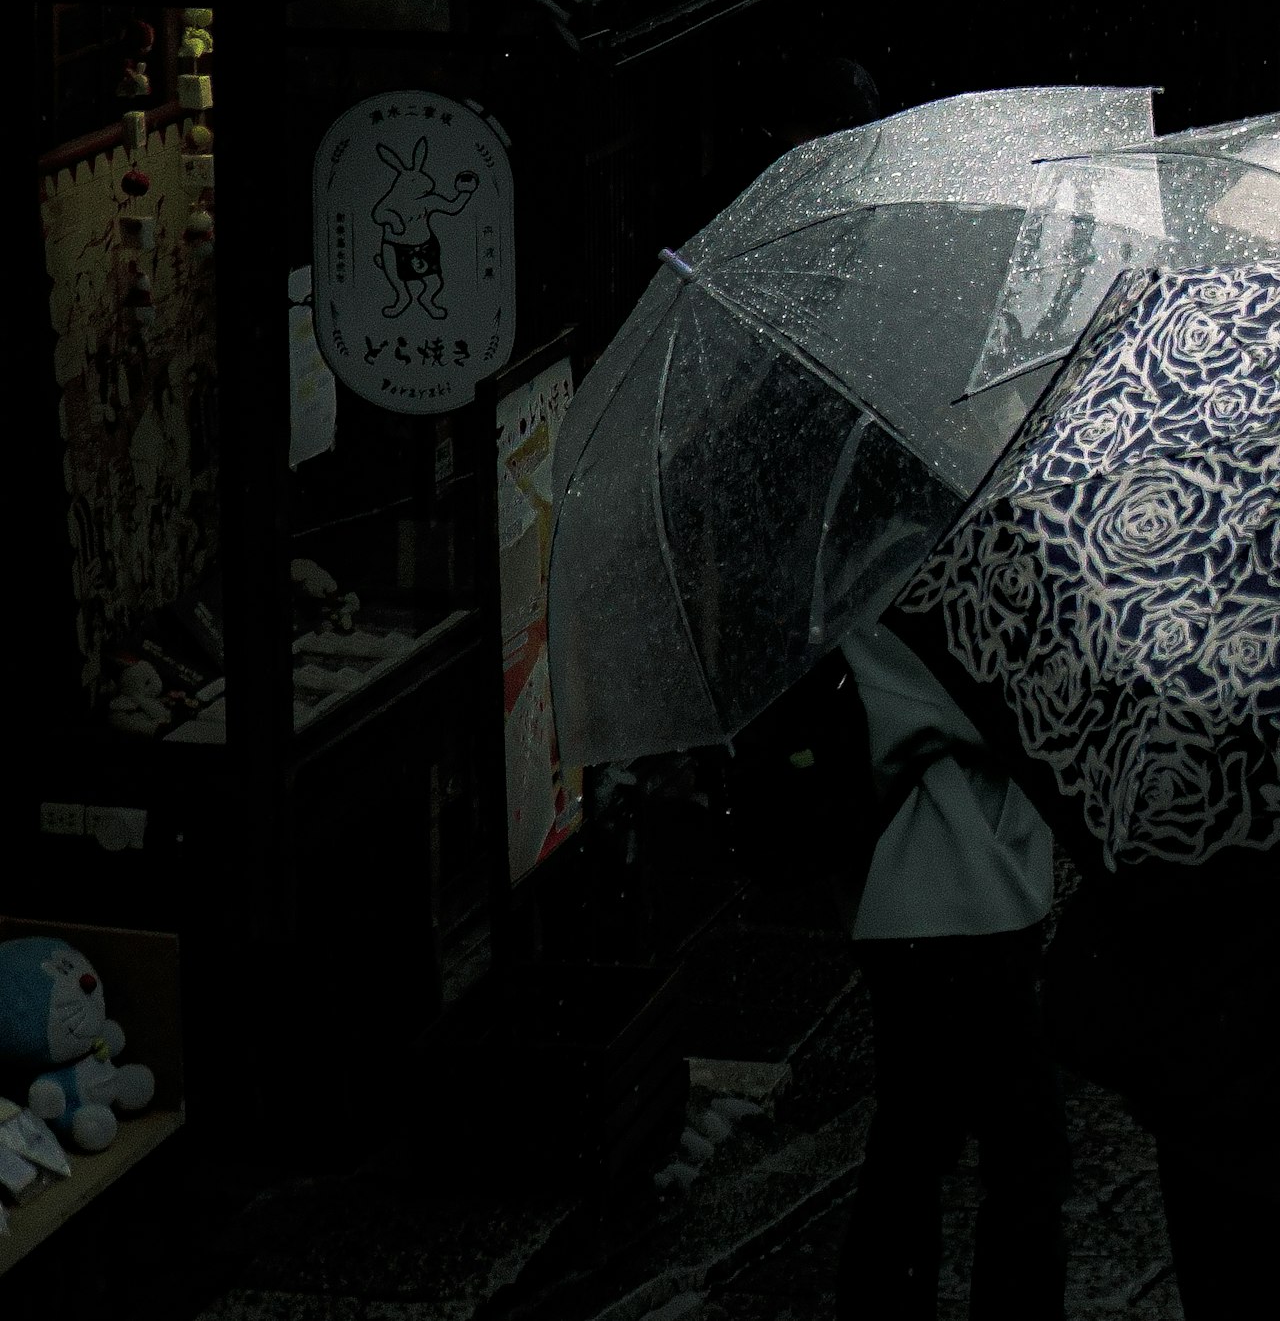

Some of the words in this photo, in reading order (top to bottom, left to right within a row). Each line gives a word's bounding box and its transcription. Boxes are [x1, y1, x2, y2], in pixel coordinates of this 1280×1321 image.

[364, 336, 471, 368] どら焼き
[381, 378, 452, 400] Dorayaki
